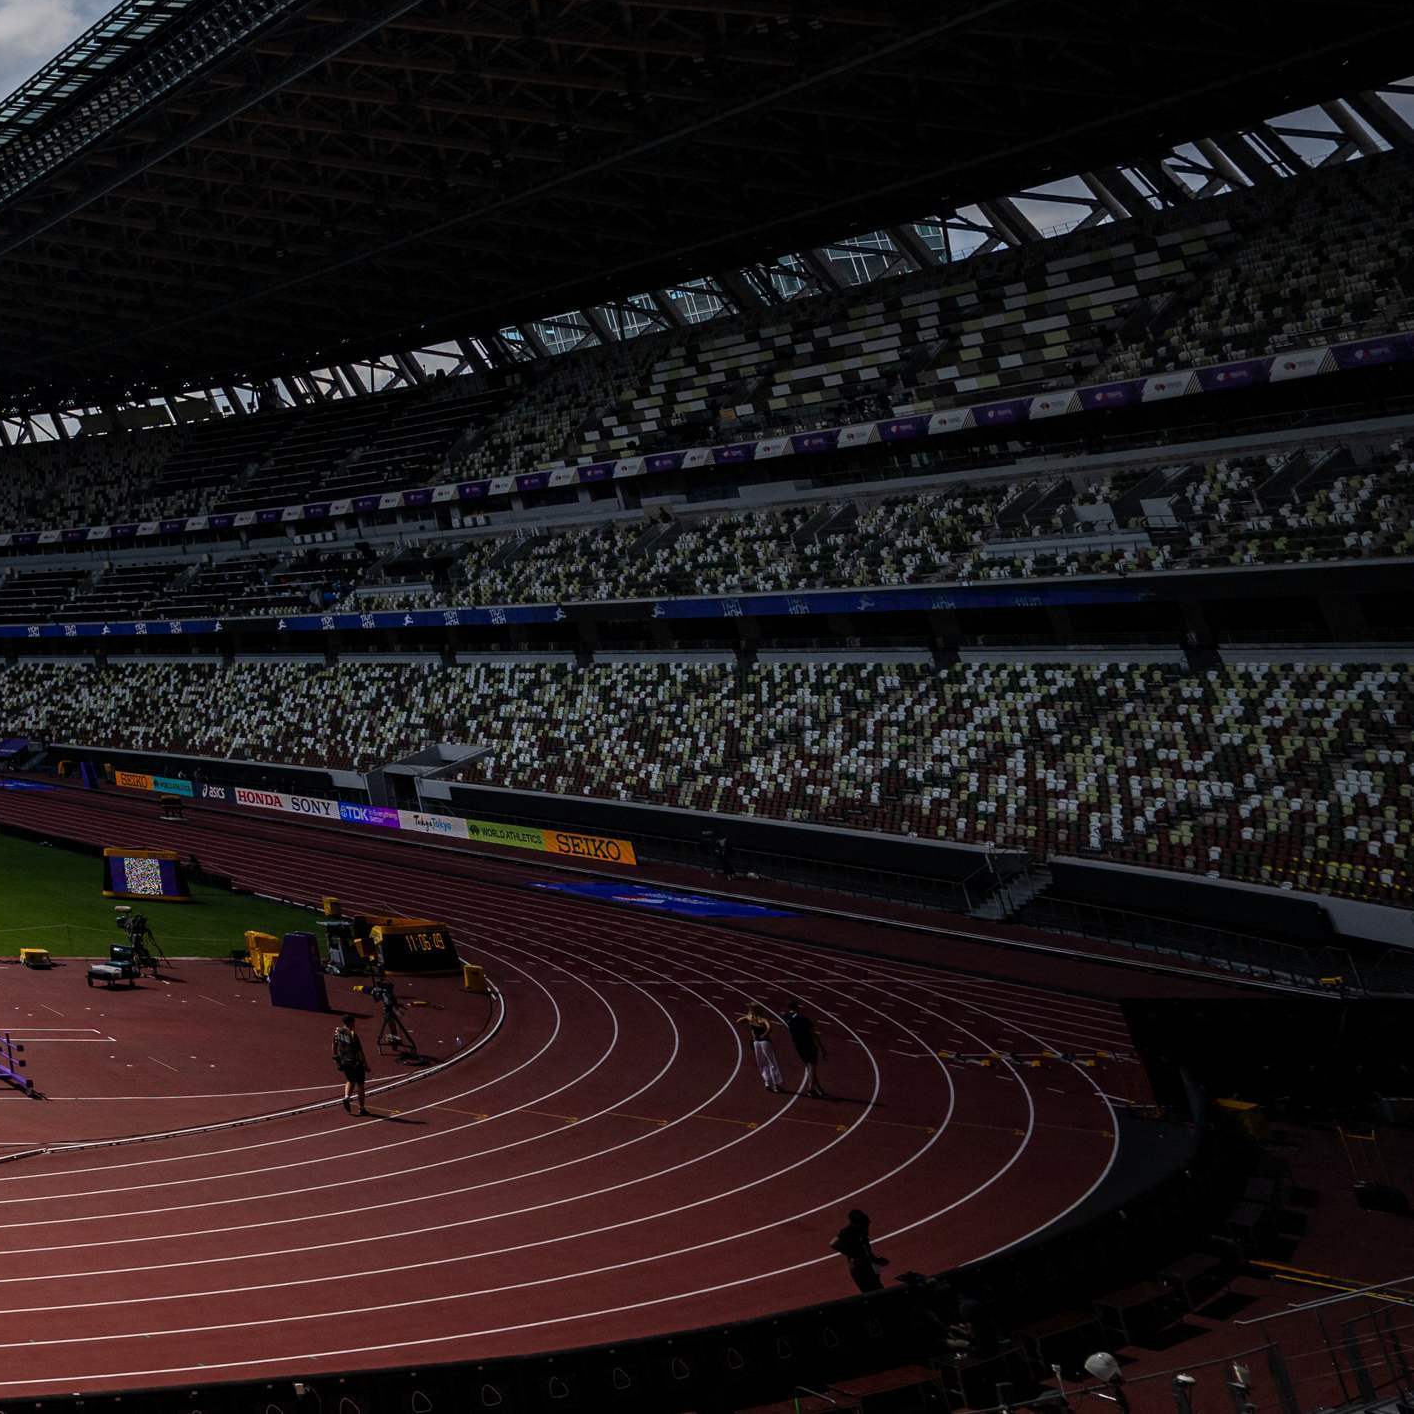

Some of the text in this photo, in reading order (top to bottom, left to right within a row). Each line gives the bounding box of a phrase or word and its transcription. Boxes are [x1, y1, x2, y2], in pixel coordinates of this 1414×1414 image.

[120, 773, 148, 788] SEIKO
[209, 786, 226, 800] asics
[238, 790, 283, 808] HONDA
[291, 797, 332, 815] SONY
[346, 807, 369, 822] TDK
[482, 827, 542, 845] WORLD ATHLETICS
[555, 833, 621, 861] SEIKO
